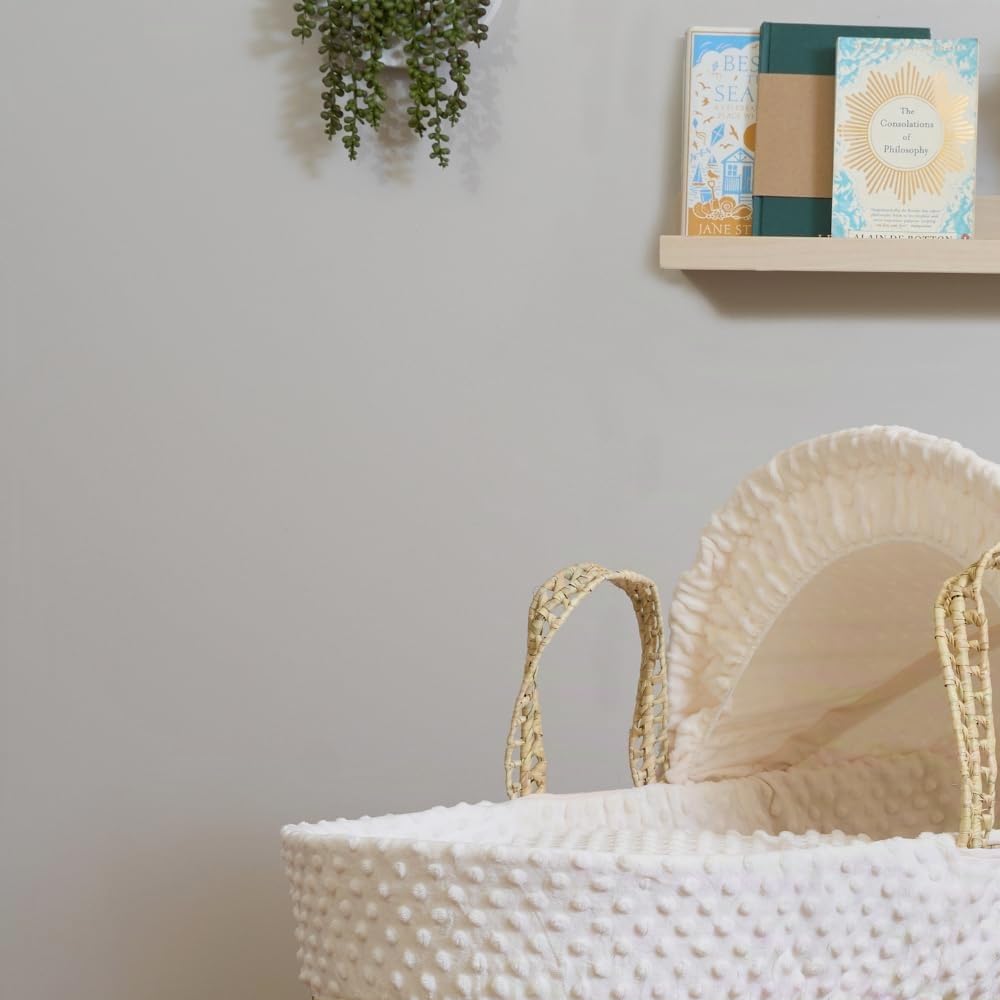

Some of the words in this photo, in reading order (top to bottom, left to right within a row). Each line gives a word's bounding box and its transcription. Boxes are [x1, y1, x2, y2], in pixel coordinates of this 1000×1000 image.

[900, 107, 915, 115] The
[880, 119, 934, 128] Consolations
[902, 133, 912, 141] of
[883, 144, 929, 157] Philosophy
[699, 222, 731, 235] JANE
